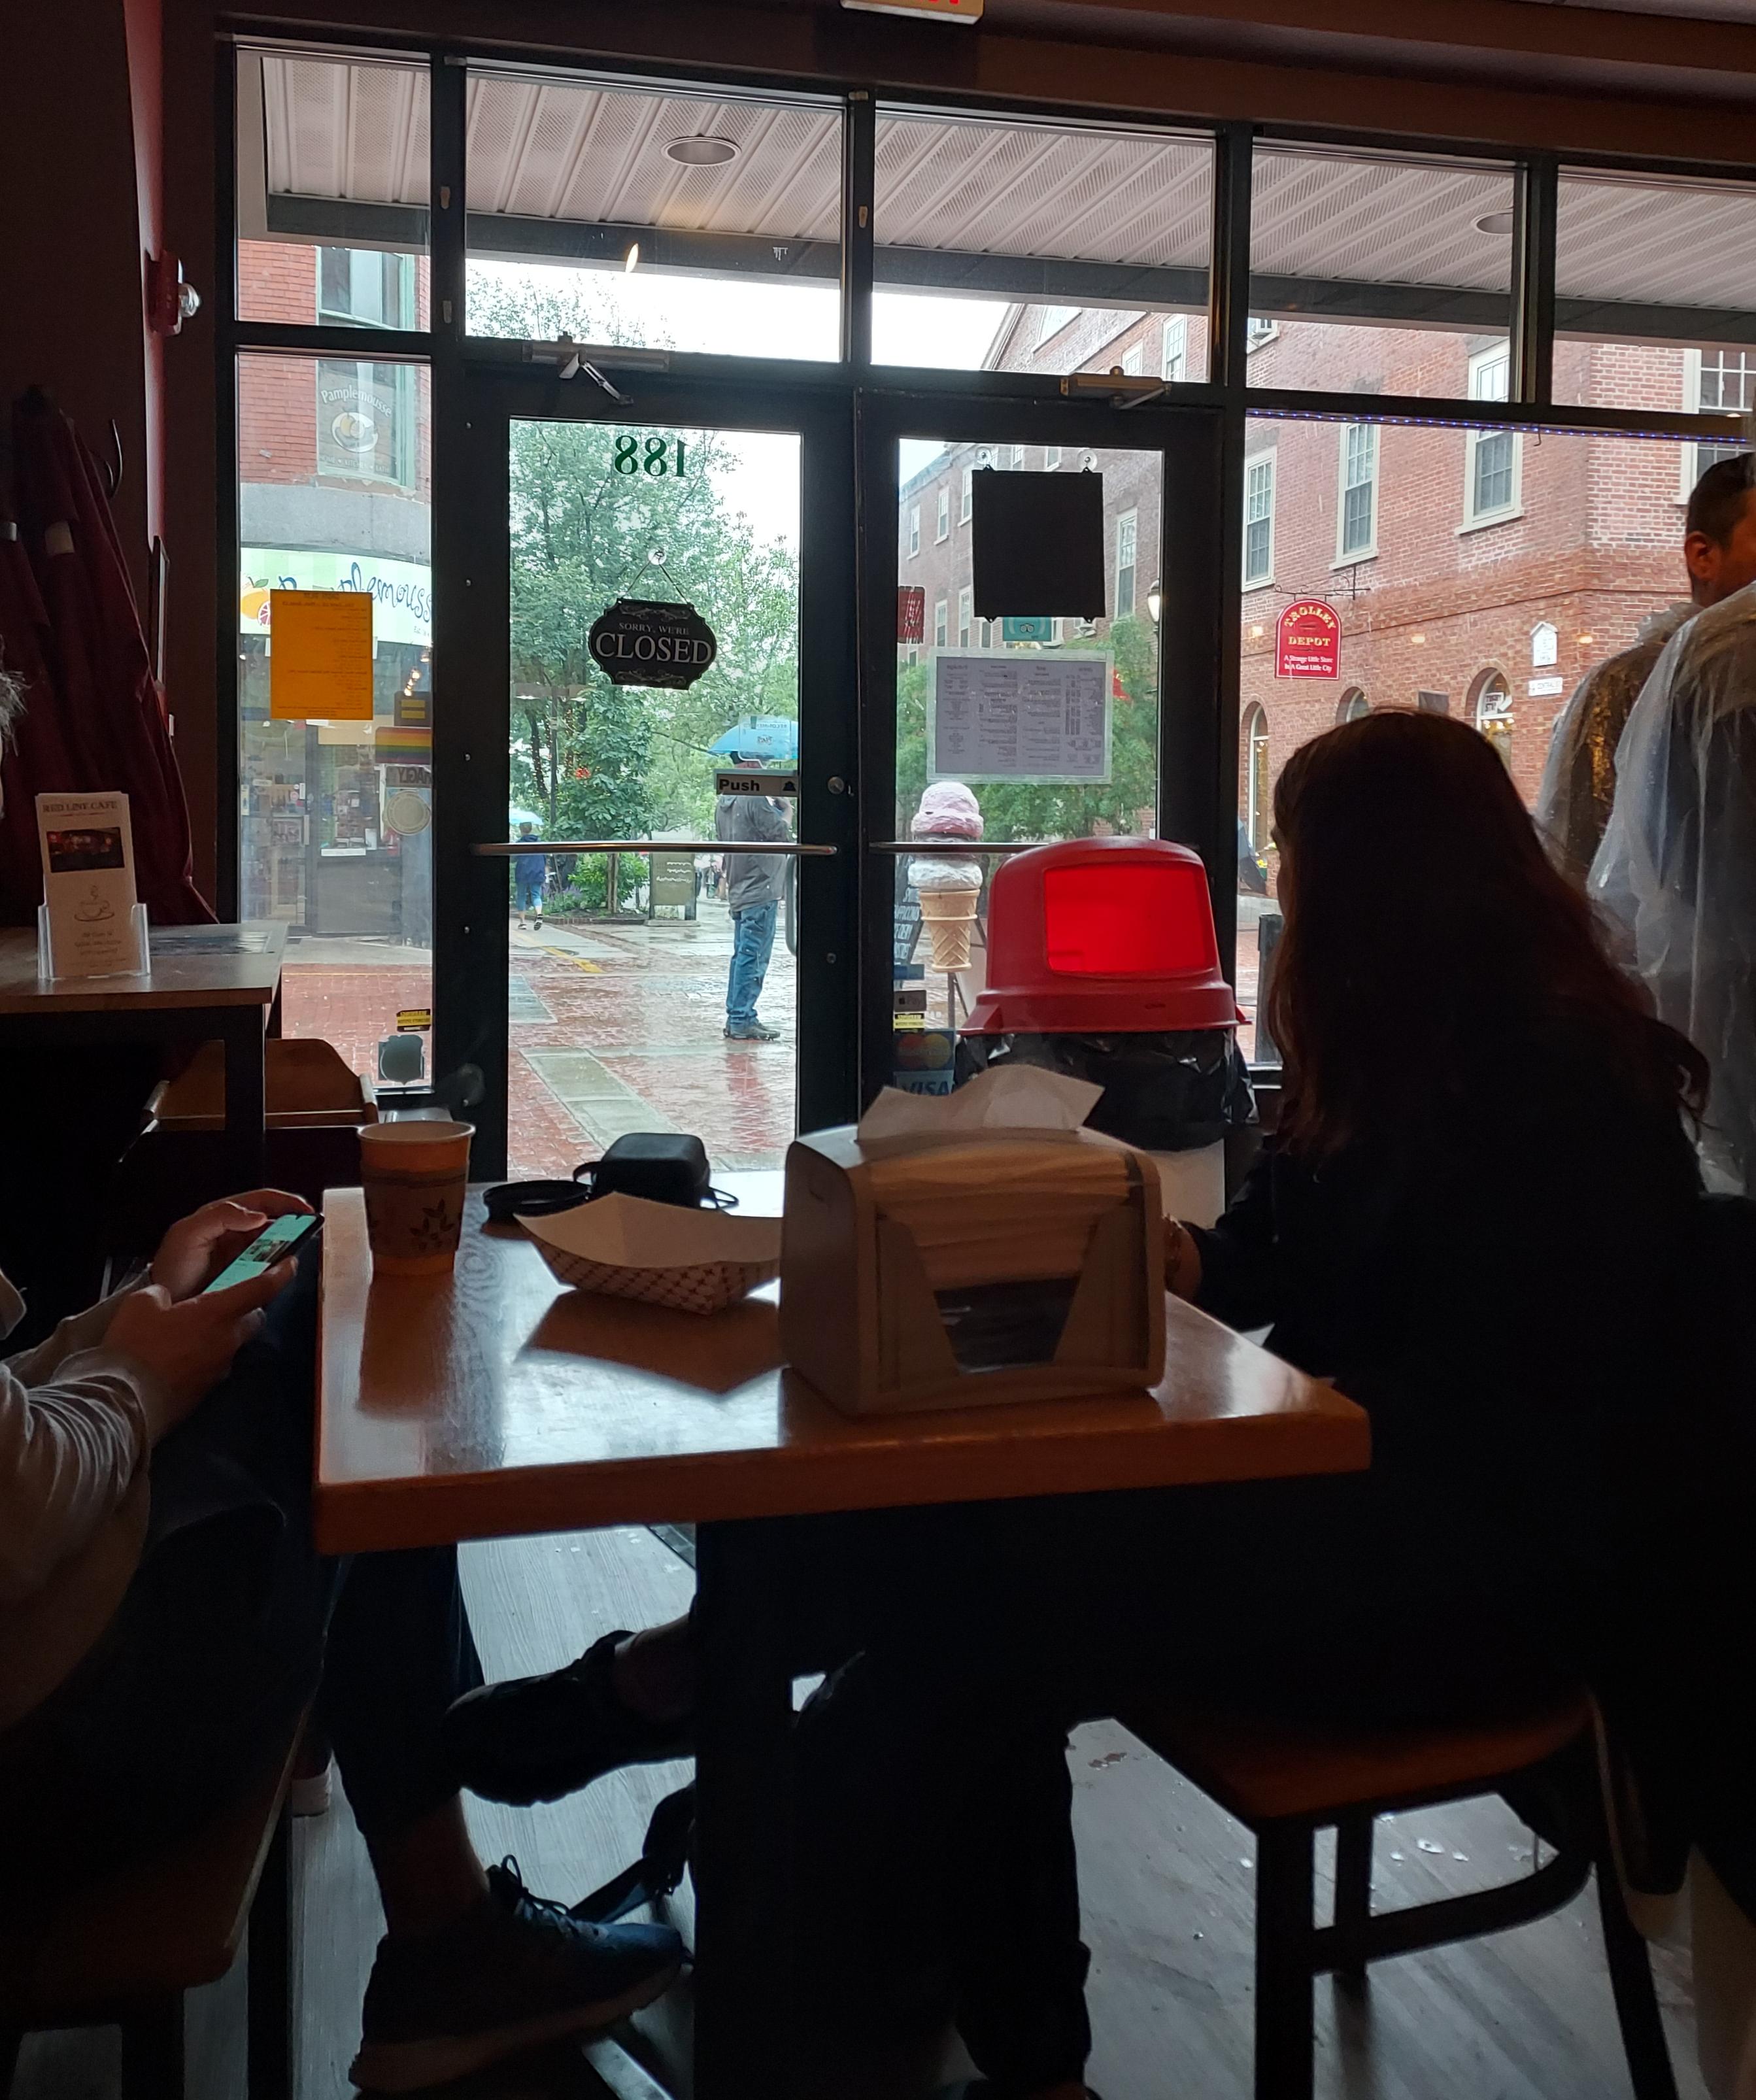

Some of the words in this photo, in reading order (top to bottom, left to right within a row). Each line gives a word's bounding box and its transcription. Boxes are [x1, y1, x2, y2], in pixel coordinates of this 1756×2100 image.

[320, 384, 392, 417] Pamplemousse
[1284, 606, 1336, 629] TROLLEY
[618, 621, 654, 634] SORRY,
[658, 624, 690, 635] WE'RE
[596, 632, 713, 665] CLOSED
[1289, 637, 1330, 646] DEPOT
[1323, 665, 1332, 673] City
[719, 779, 760, 792] Push
[42, 803, 64, 813] RED
[902, 1081, 949, 1096] VISA
